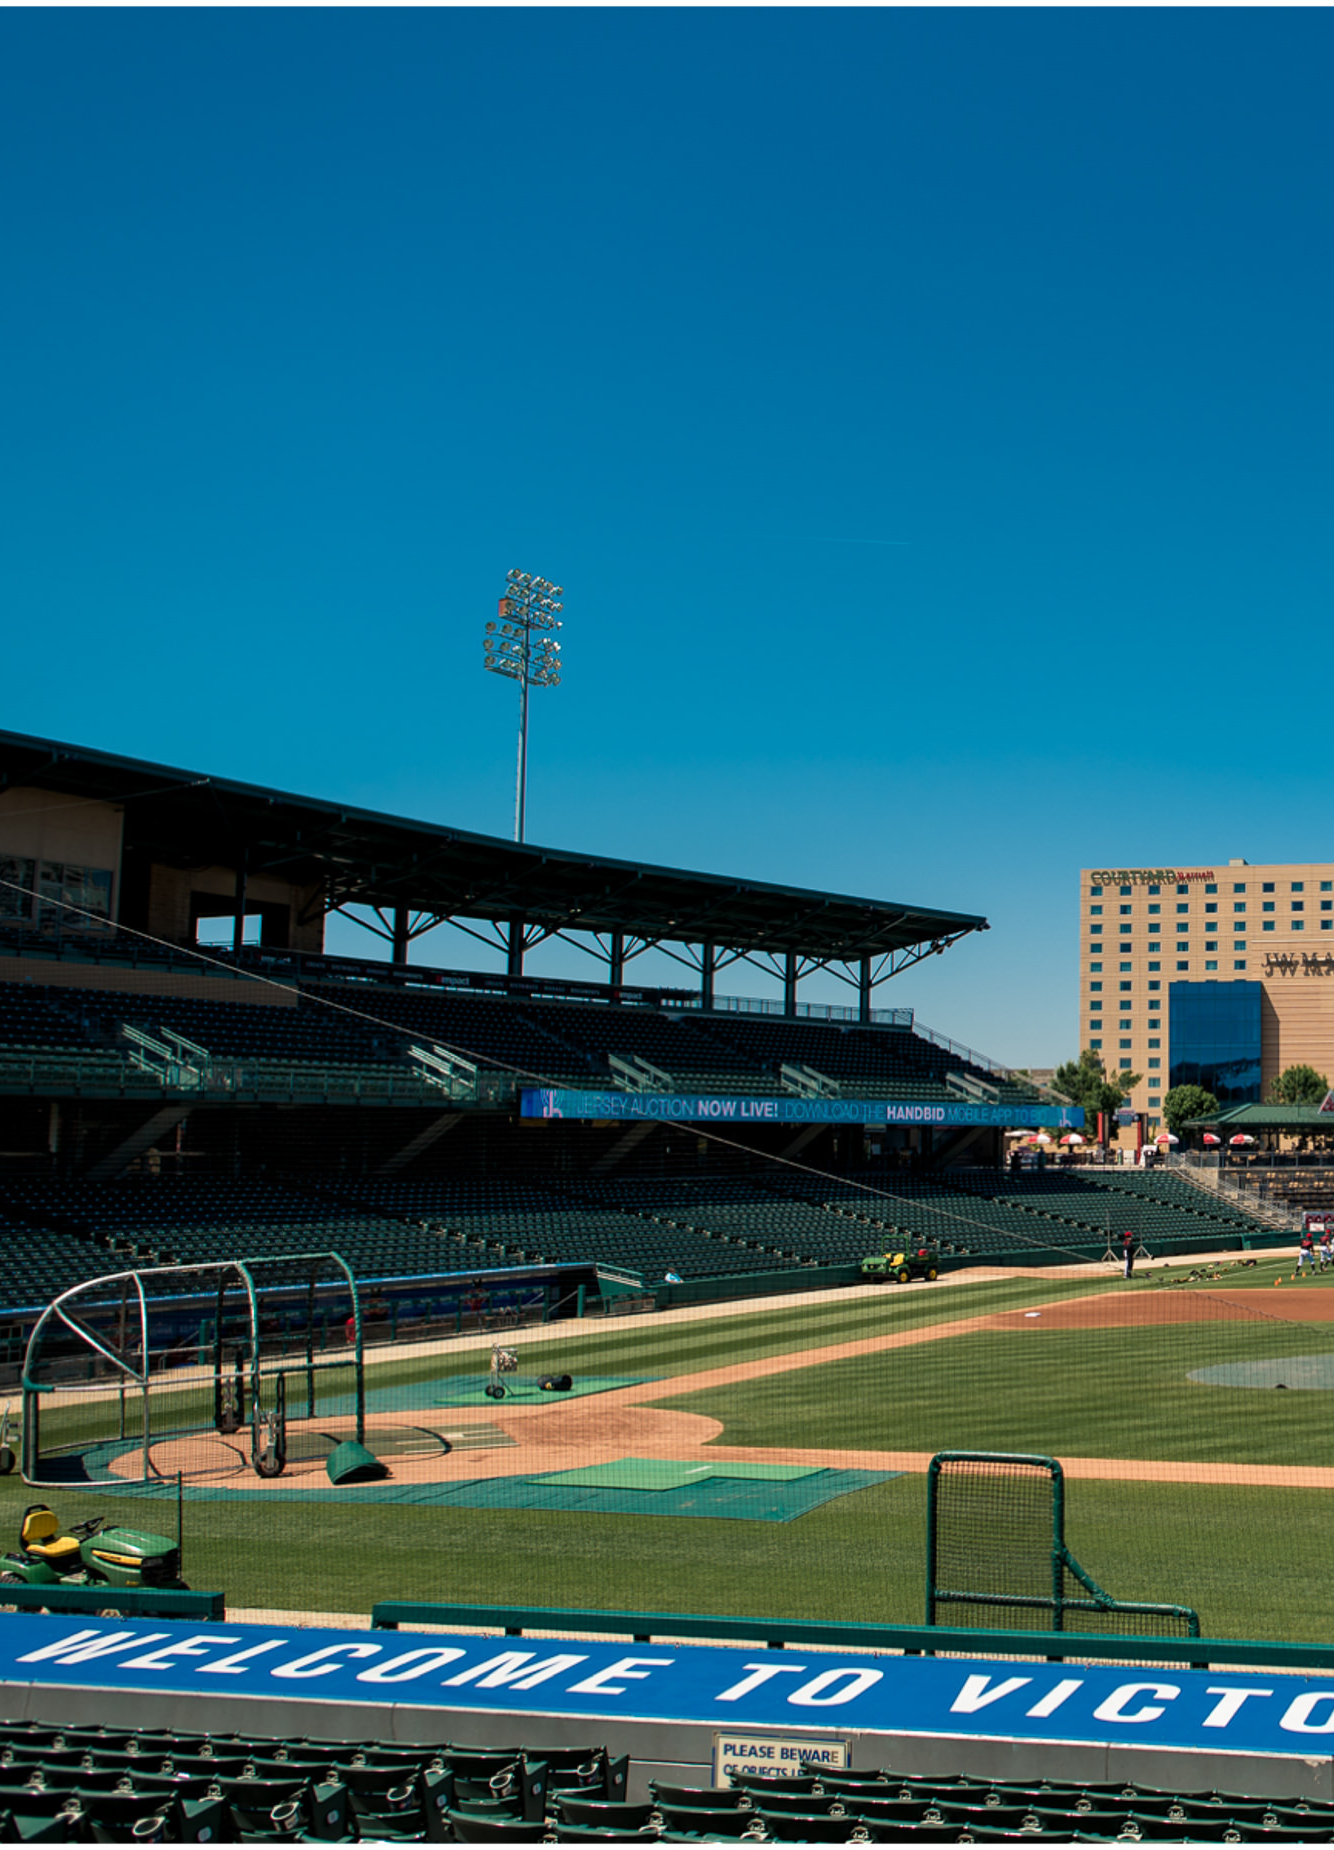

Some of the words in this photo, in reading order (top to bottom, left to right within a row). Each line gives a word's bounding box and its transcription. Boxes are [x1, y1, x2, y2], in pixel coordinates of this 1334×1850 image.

[1090, 869, 1177, 883] COURTYARD
[1261, 952, 1298, 970] JW
[577, 1096, 627, 1115] JERSEY
[630, 1098, 694, 1117] AUCTION
[698, 1100, 737, 1117] NOW
[740, 1101, 779, 1118] LIVE!
[785, 1103, 859, 1120] DOWNLOAD
[886, 1106, 945, 1121] HANDBID
[947, 1107, 989, 1122] MOBILE
[17, 1629, 674, 1695] WELCOME
[715, 1663, 884, 1706] TO
[723, 1743, 775, 1760] PLEASE
[781, 1747, 840, 1763] BEWARE
